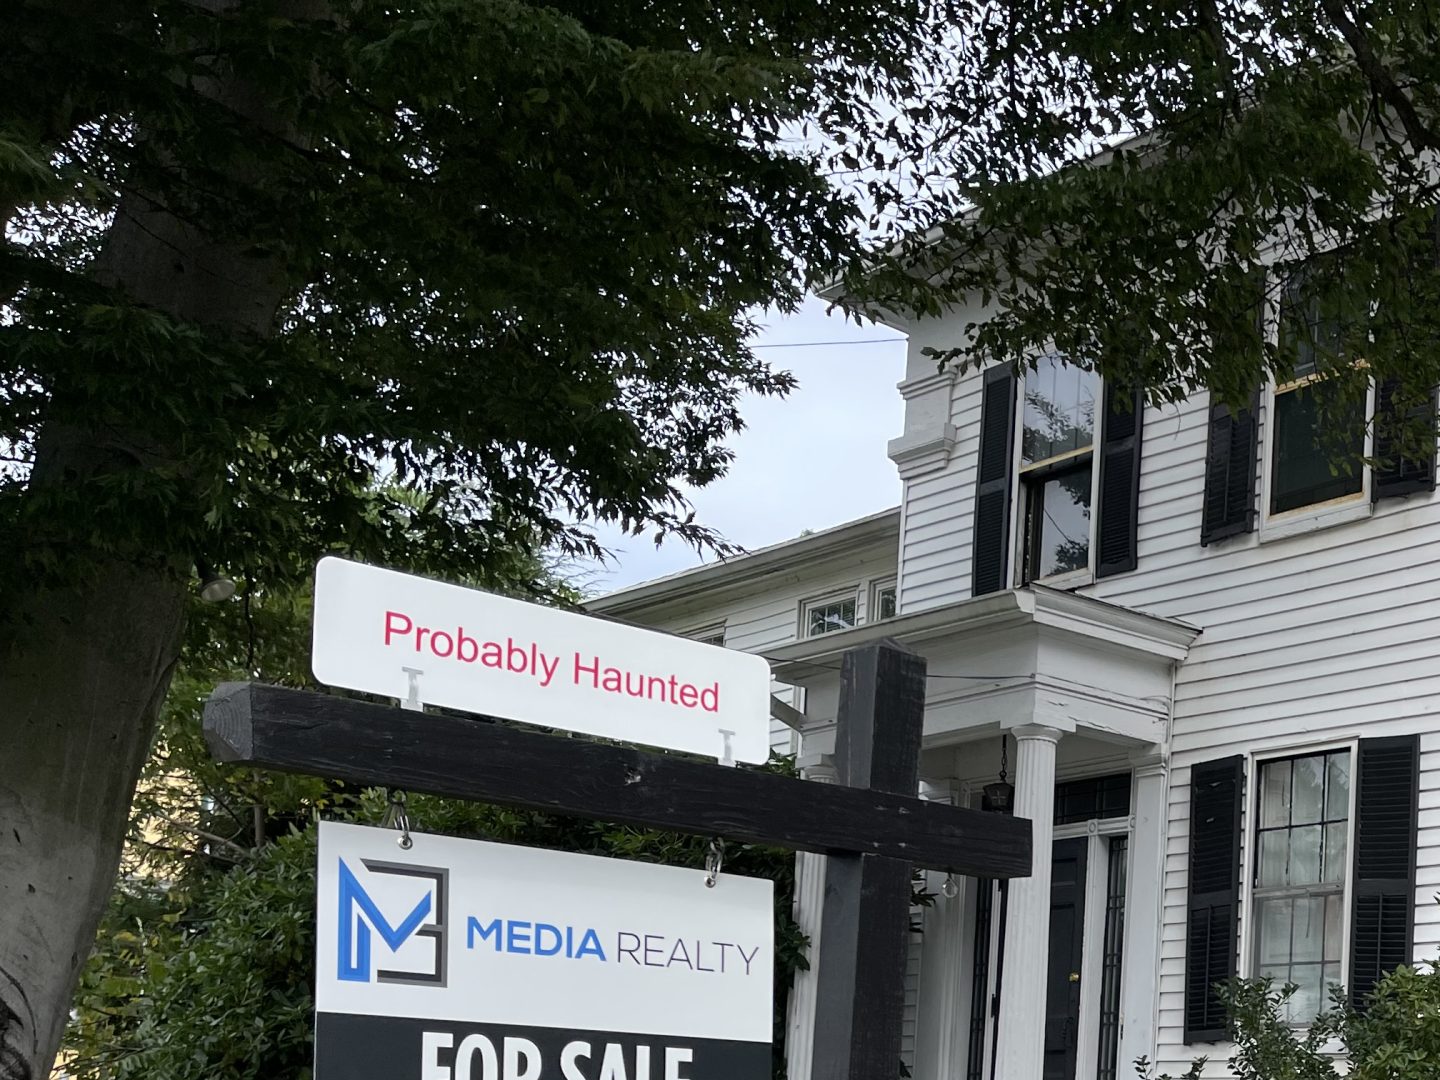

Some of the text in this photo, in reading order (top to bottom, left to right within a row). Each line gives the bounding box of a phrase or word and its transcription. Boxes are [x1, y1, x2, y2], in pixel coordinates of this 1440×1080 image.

[384, 611, 720, 713] Probably Haunted
[466, 915, 760, 976] MEDIA REALTY
